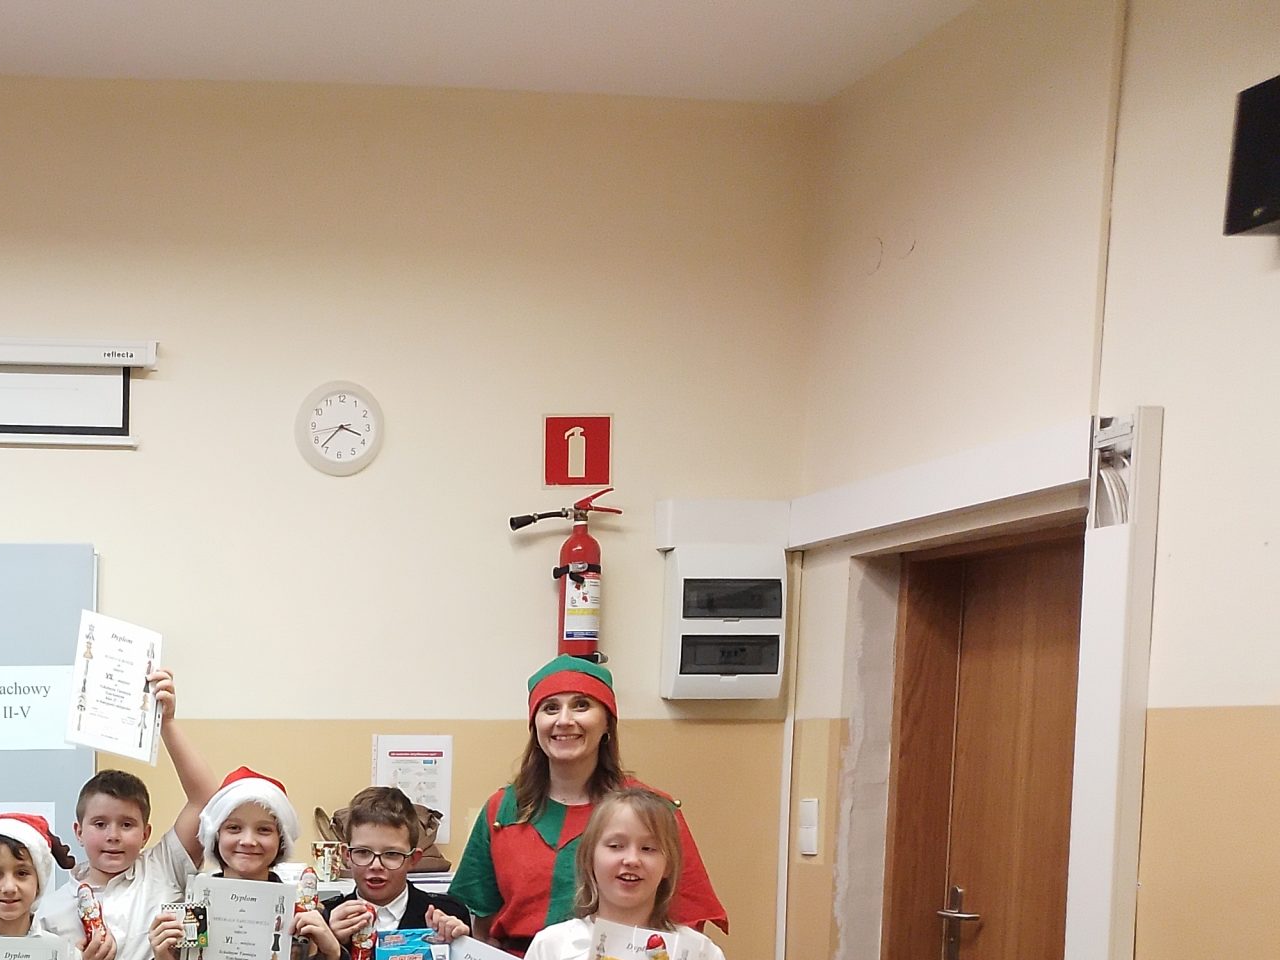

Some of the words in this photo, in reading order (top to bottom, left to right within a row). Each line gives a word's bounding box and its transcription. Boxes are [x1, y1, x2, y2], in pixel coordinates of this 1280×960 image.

[103, 350, 134, 358] reflecta
[338, 394, 346, 403] 12
[362, 410, 368, 418] 2
[311, 422, 316, 430] 9
[365, 424, 371, 432] 3
[324, 446, 329, 454] 7
[336, 451, 342, 459] 6
[3, 705, 31, 719] II-V
[230, 893, 257, 903] Dyplom
[4, 951, 31, 960] Dyplom
